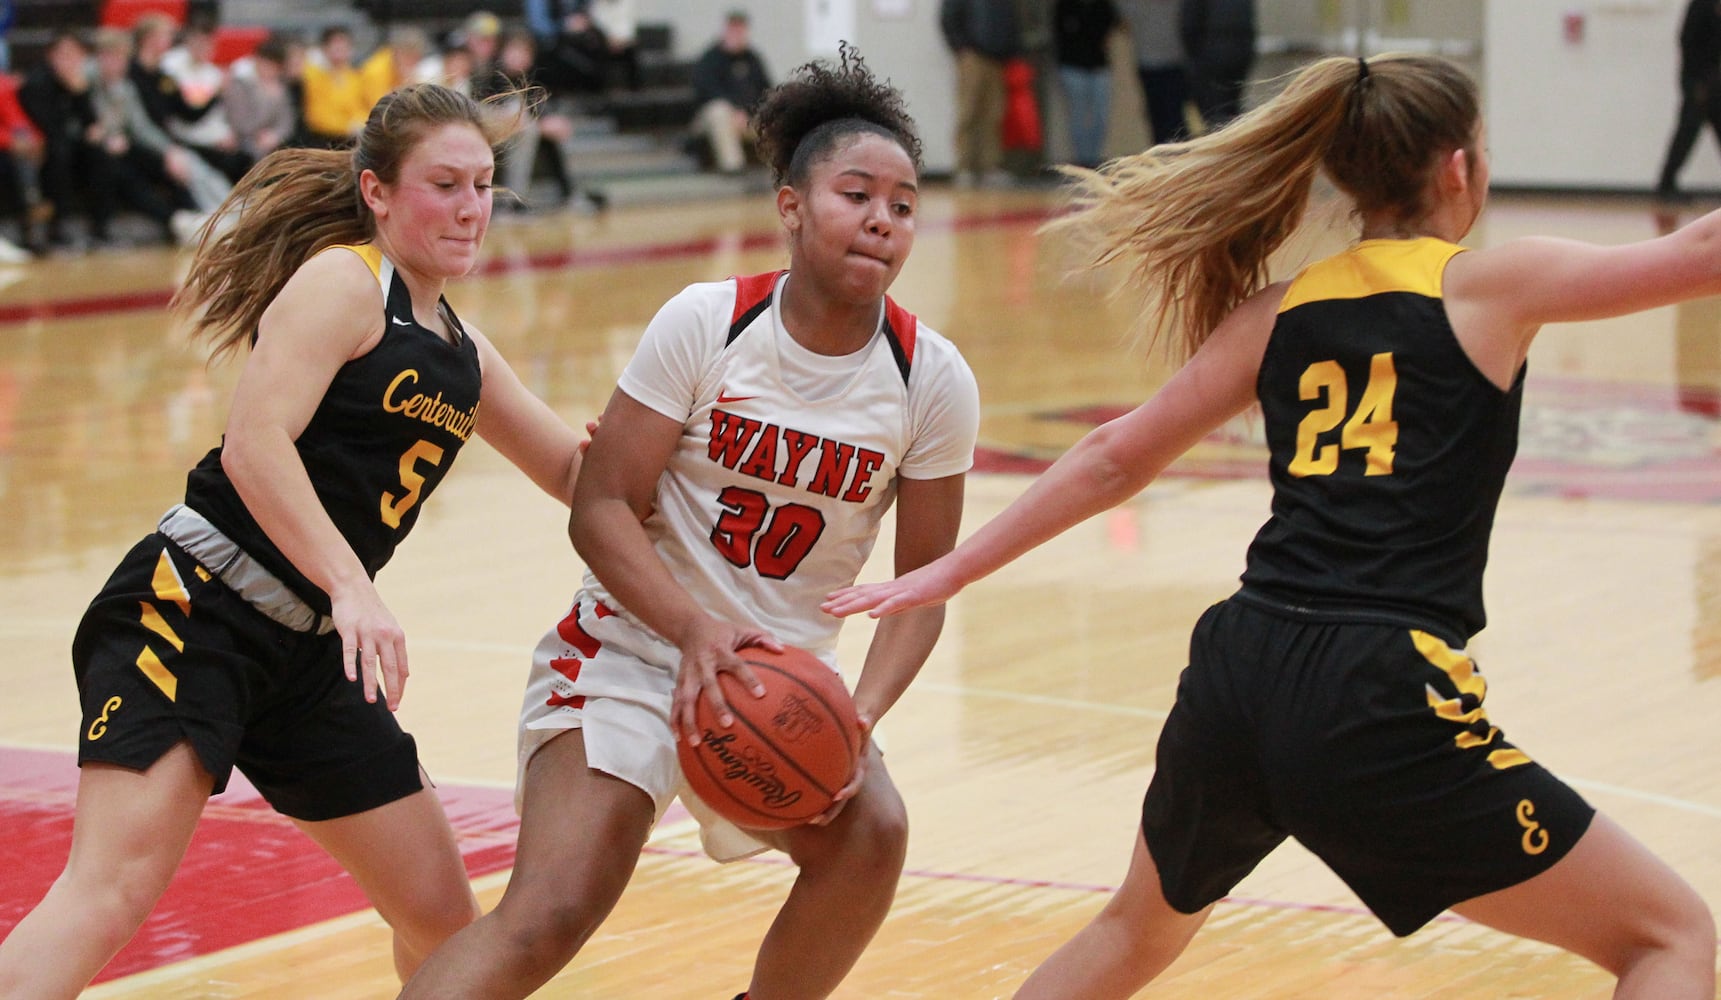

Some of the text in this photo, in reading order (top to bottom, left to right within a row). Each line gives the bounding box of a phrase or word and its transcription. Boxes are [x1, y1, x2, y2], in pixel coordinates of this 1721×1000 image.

[382, 368, 480, 441] Centervil
[1288, 352, 1398, 478] 24
[380, 439, 445, 529] 5
[708, 408, 885, 503] WAYNE
[709, 485, 826, 581] 30
[703, 727, 801, 808] Rawlings
